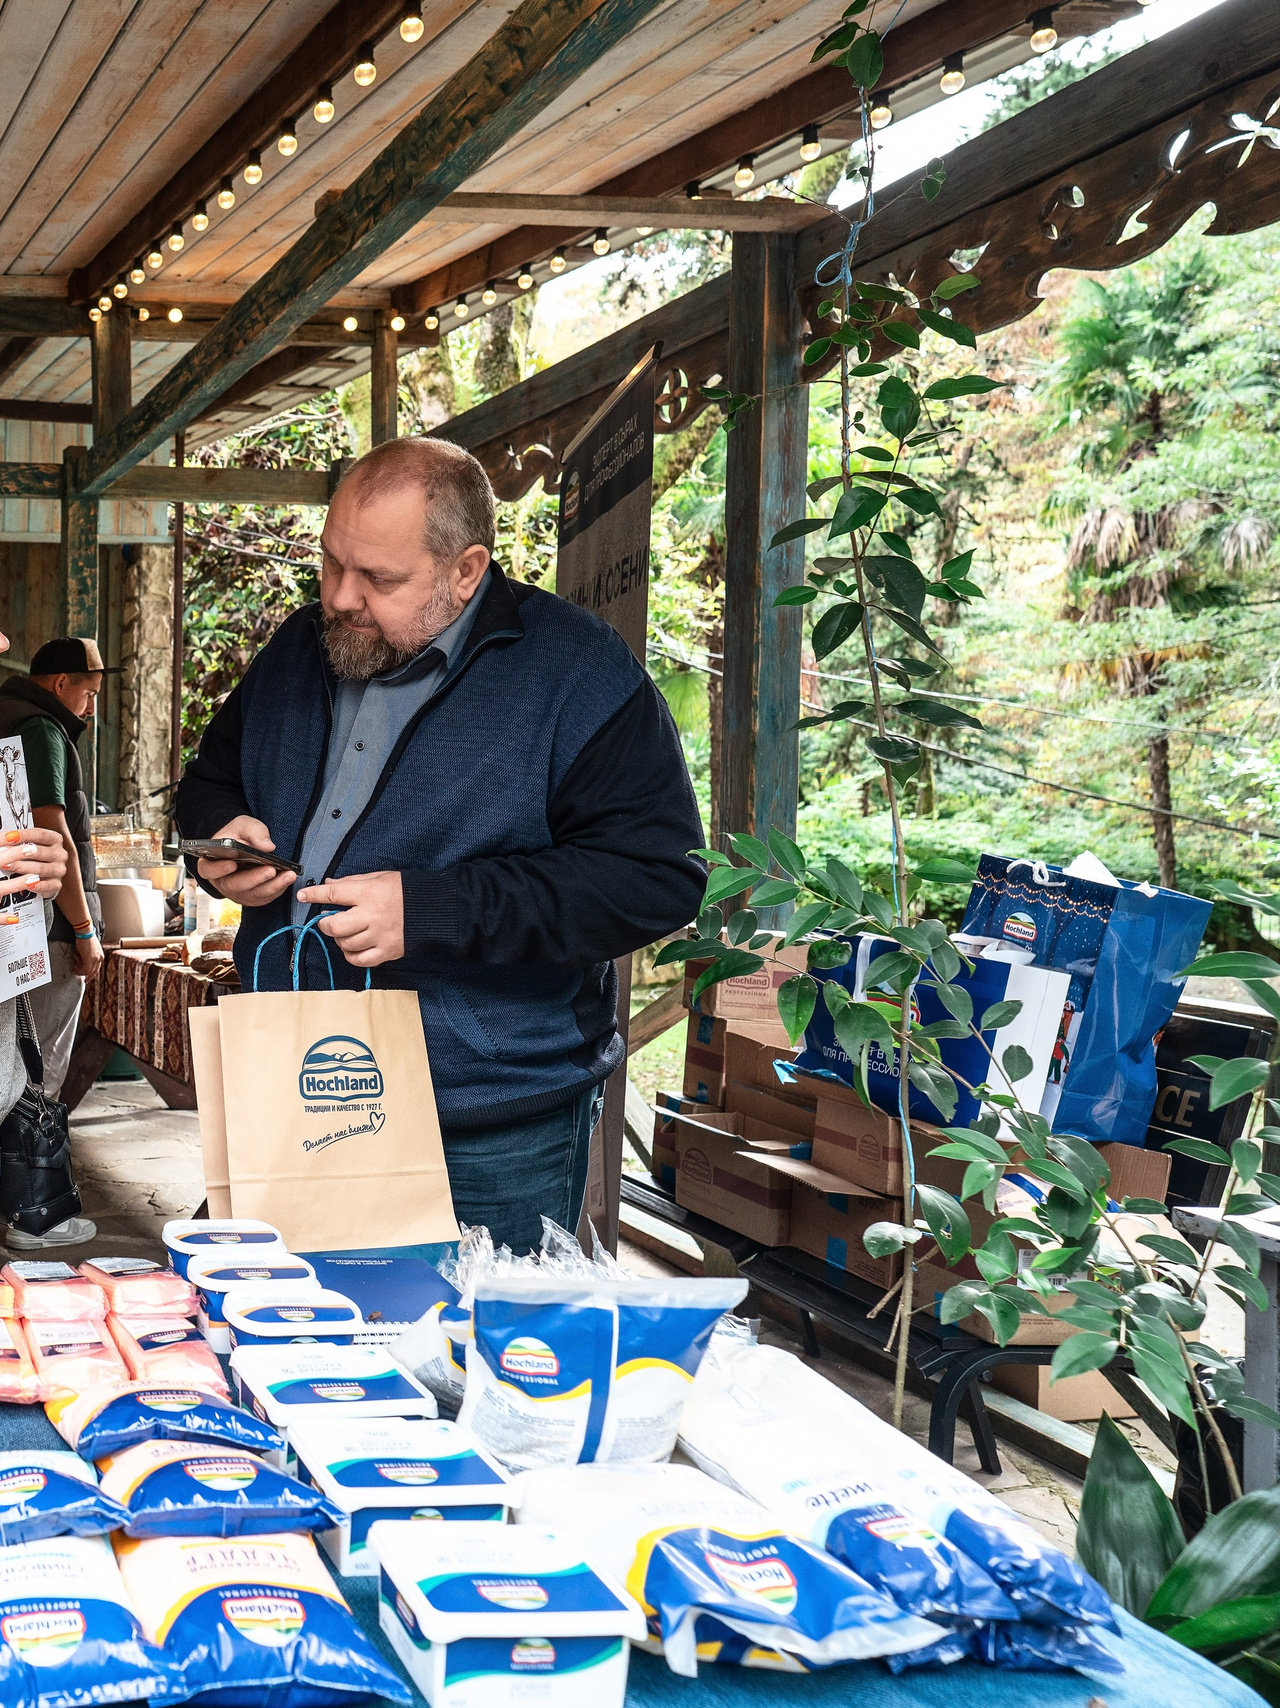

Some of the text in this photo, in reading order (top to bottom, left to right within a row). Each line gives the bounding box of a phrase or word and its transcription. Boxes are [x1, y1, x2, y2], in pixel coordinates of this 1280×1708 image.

[618, 412, 639, 446] СЫРАХ
[606, 545, 648, 604] ОСЕНИ
[1005, 922, 1036, 939] Hochland
[7, 956, 29, 973] БОЛЬШЕ
[15, 971, 31, 987] О НАС
[729, 976, 767, 987] Hochland
[725, 988, 770, 999] PROFESSIONAL
[822, 1046, 837, 1059] ДЛЯ
[305, 1074, 379, 1093] Hochland
[304, 1104, 331, 1113] ТРАДИЦИИ
[331, 1104, 337, 1112] И
[336, 1103, 361, 1112] КАЧЕСТВО
[360, 1103, 366, 1111] С
[366, 1103, 378, 1111] 1927
[303, 1123, 374, 1152] Делает нас ближе
[504, 1356, 554, 1371] Hochland
[500, 1370, 559, 1387] PROFESSIONAL
[318, 1387, 361, 1395] Hochland
[180, 1458, 251, 1467] PROFESSIONAL
[373, 1461, 432, 1469] PROFESSIONAL
[190, 1466, 252, 1474] Hochland
[218, 1587, 300, 1599] PROFESSIONAL
[230, 1604, 298, 1615] Hochland
[9, 1618, 79, 1634] Hochland
